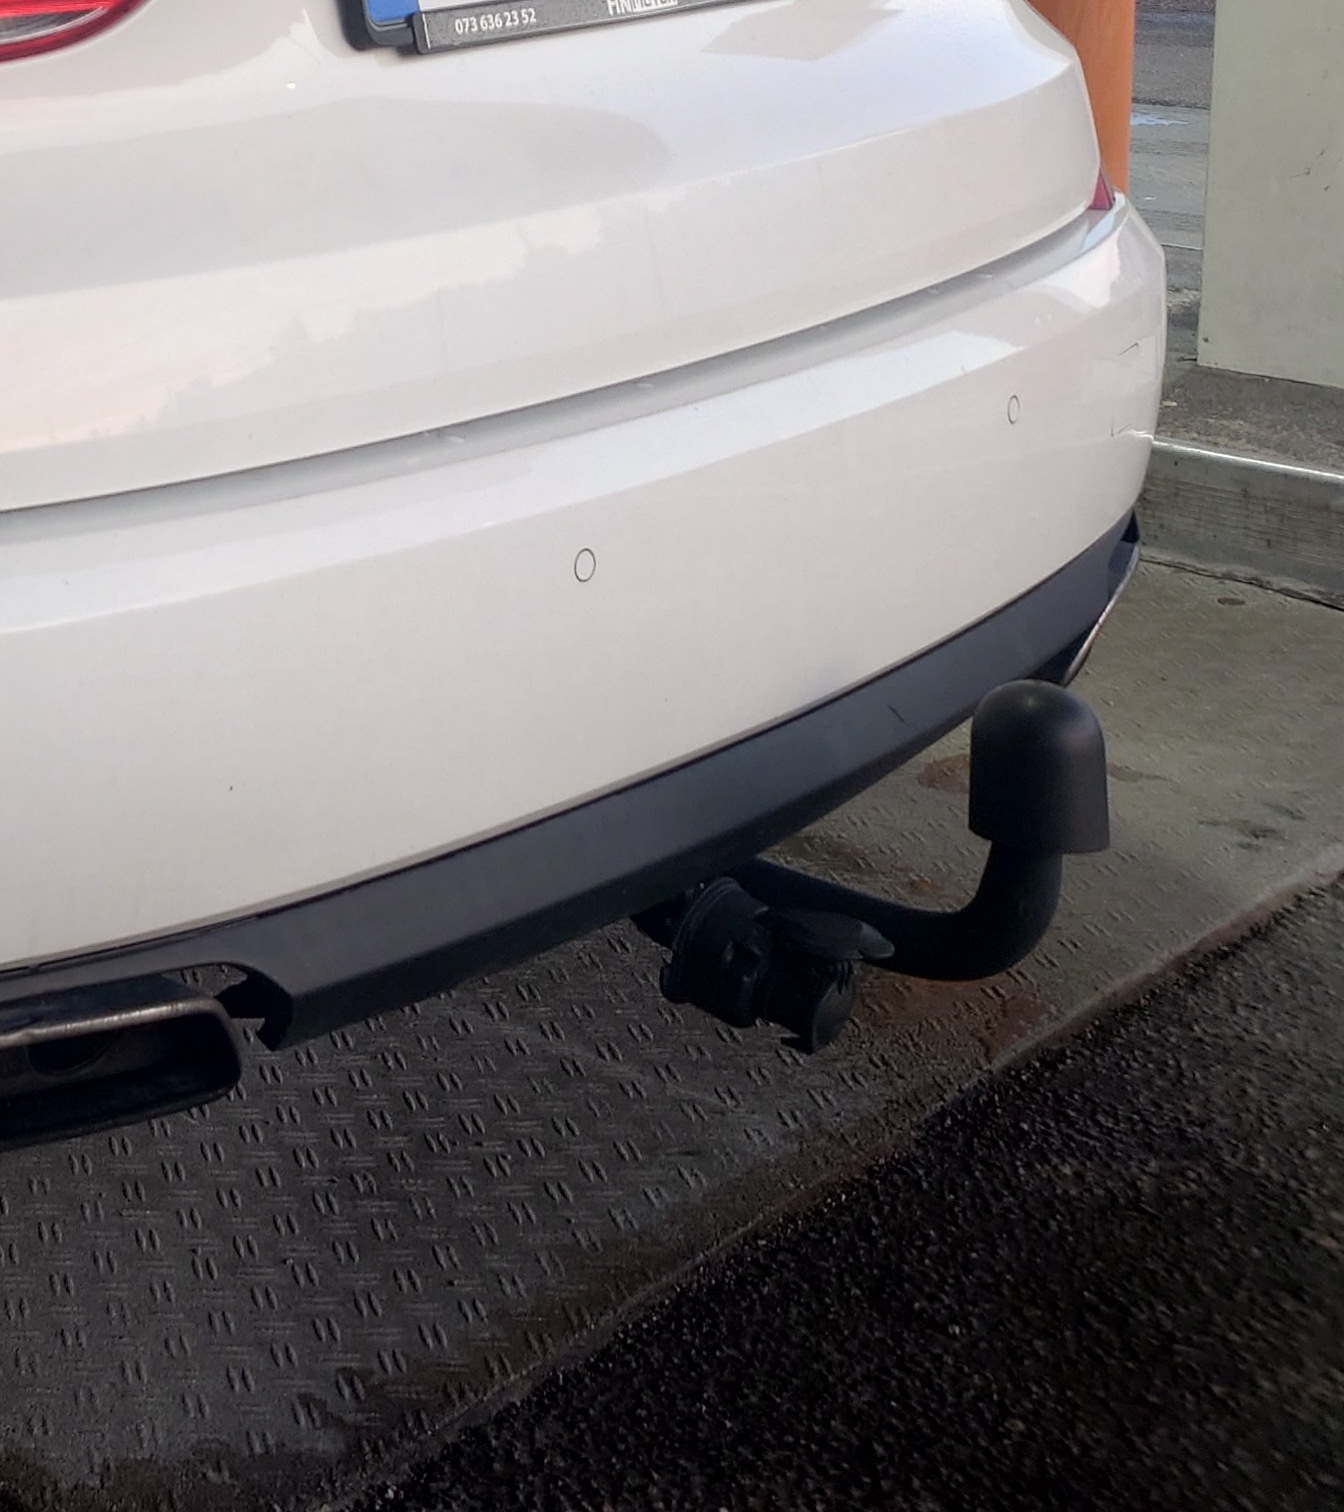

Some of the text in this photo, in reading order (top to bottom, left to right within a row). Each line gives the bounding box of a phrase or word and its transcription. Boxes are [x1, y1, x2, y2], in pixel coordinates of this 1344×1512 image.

[455, 7, 537, 36] 073 636 23 52
